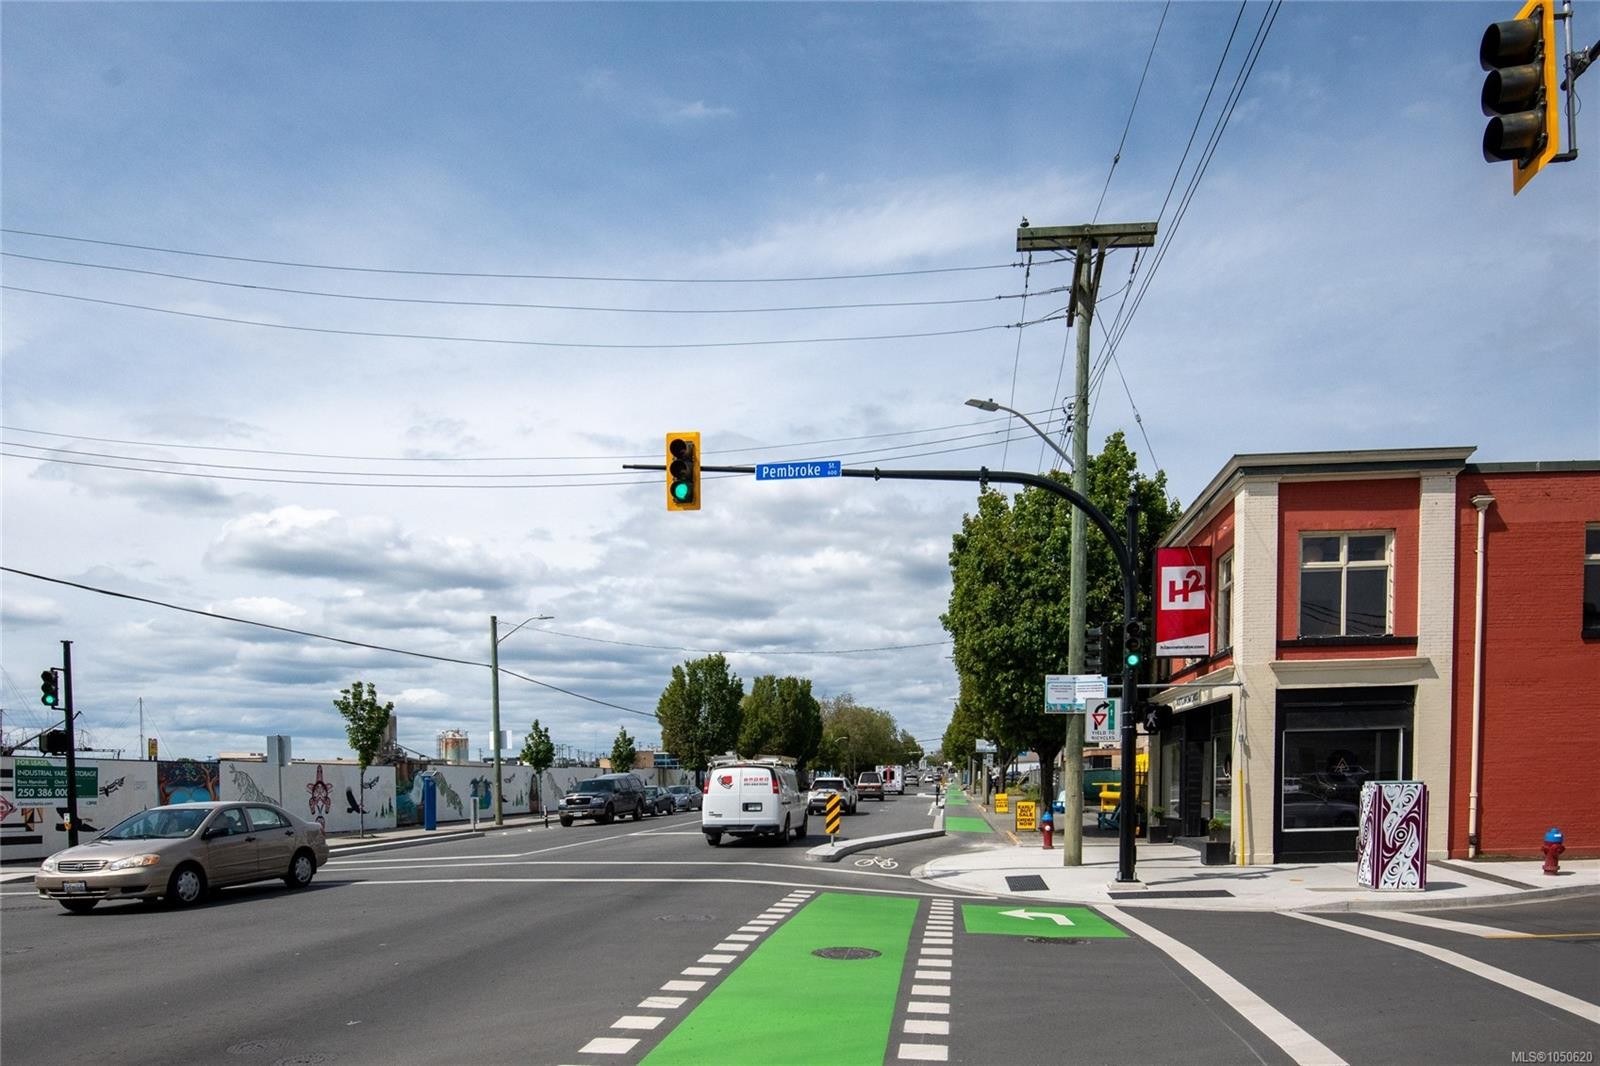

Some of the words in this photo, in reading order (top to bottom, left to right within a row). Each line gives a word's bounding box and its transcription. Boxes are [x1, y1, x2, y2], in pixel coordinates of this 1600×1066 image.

[762, 464, 821, 478] Pembroke
[17, 769, 52, 777] INDUSTRIAL
[17, 788, 35, 797] 250
[37, 788, 52, 797] 386
